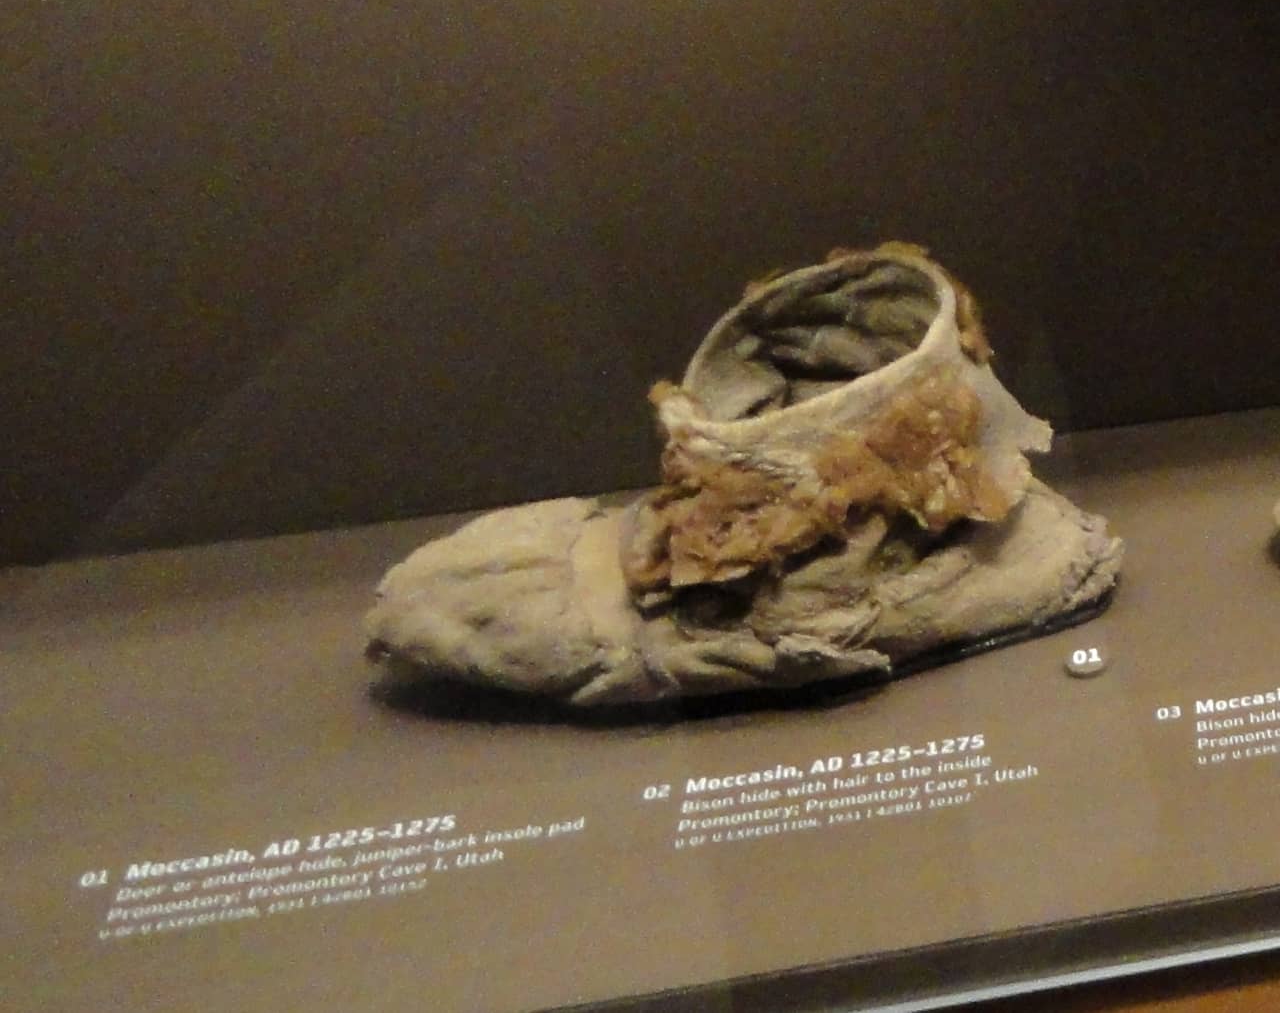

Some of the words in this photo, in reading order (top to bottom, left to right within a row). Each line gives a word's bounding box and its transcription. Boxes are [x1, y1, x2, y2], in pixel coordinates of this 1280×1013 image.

[1071, 647, 1102, 665] 01
[1156, 705, 1181, 719] 03
[1196, 717, 1244, 732] Bison
[643, 784, 670, 799] 02
[685, 764, 803, 793] Moccasin,
[810, 756, 843, 774] AD
[681, 796, 733, 813] Bison
[739, 788, 780, 803] hide
[786, 780, 826, 797] with
[832, 773, 868, 789] hair
[875, 771, 895, 783] to
[900, 765, 931, 779] the
[937, 754, 991, 773] inside
[80, 869, 106, 886] 01
[126, 848, 254, 878] Moccasin,
[263, 838, 300, 858] AD
